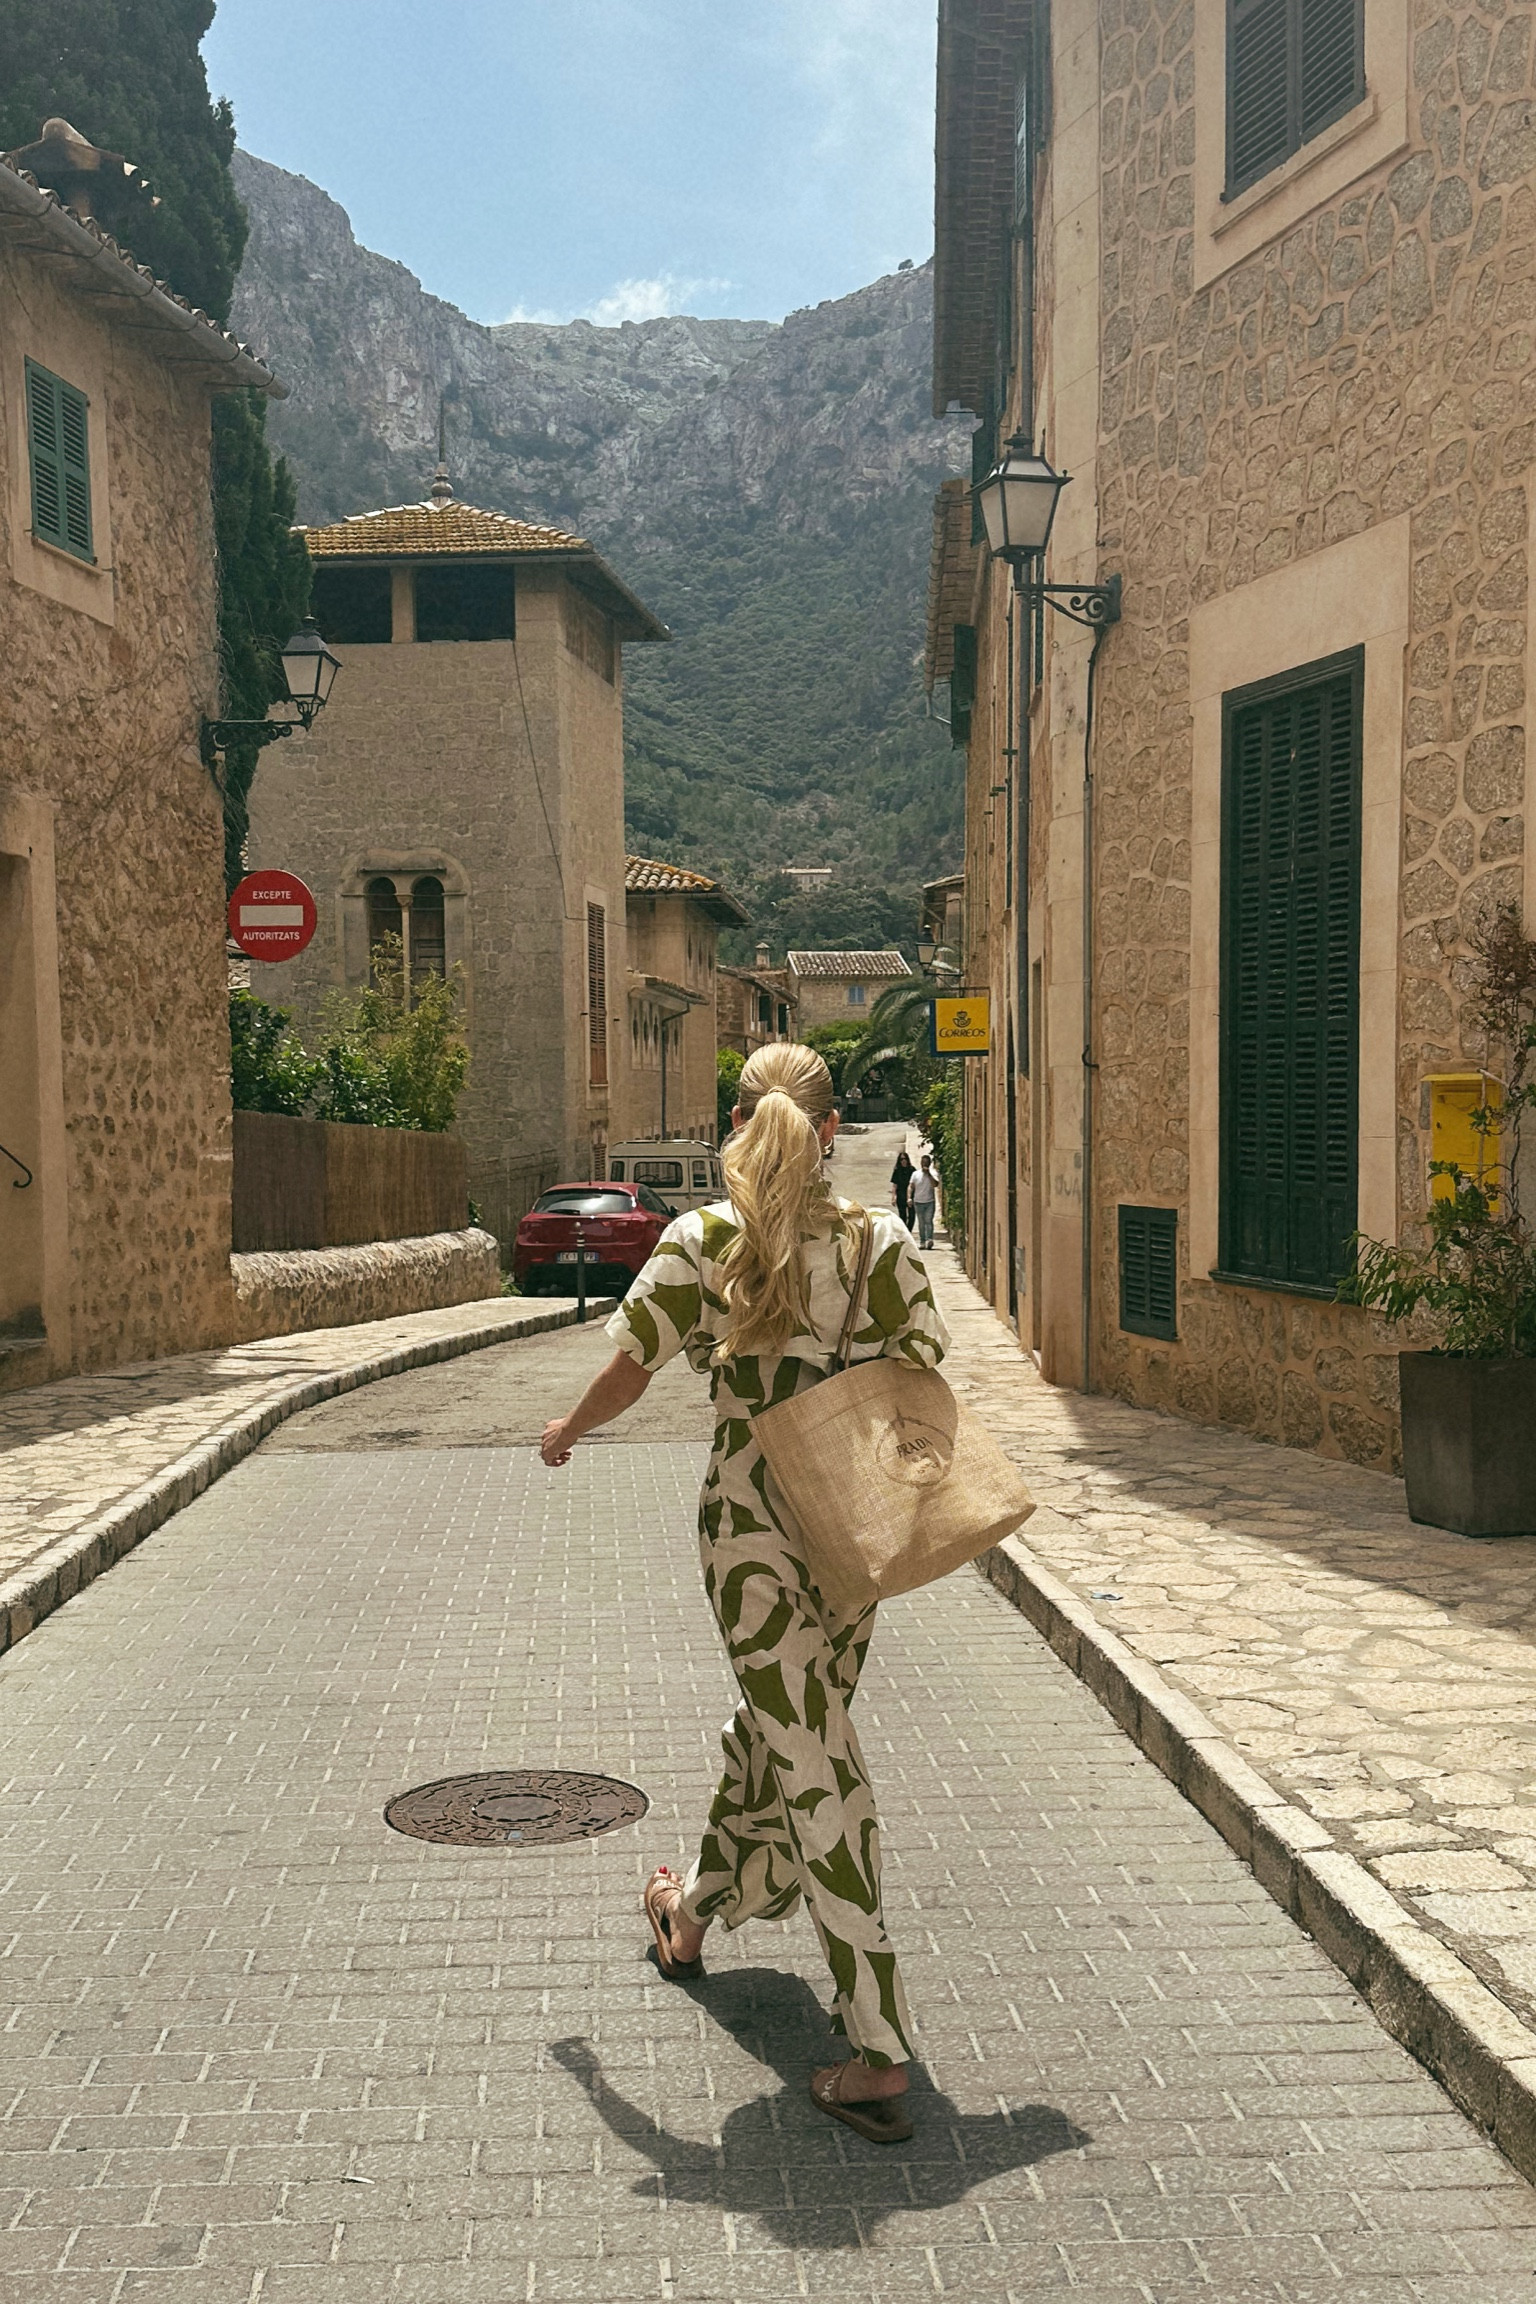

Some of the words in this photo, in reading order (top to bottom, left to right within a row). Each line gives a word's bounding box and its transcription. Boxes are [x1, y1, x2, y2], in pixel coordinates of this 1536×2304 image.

[252, 890, 292, 900] EXCEPTE
[242, 931, 300, 940] AUTORITZATS
[939, 1027, 986, 1038] CORREOS
[896, 1436, 934, 1458] PRADA
